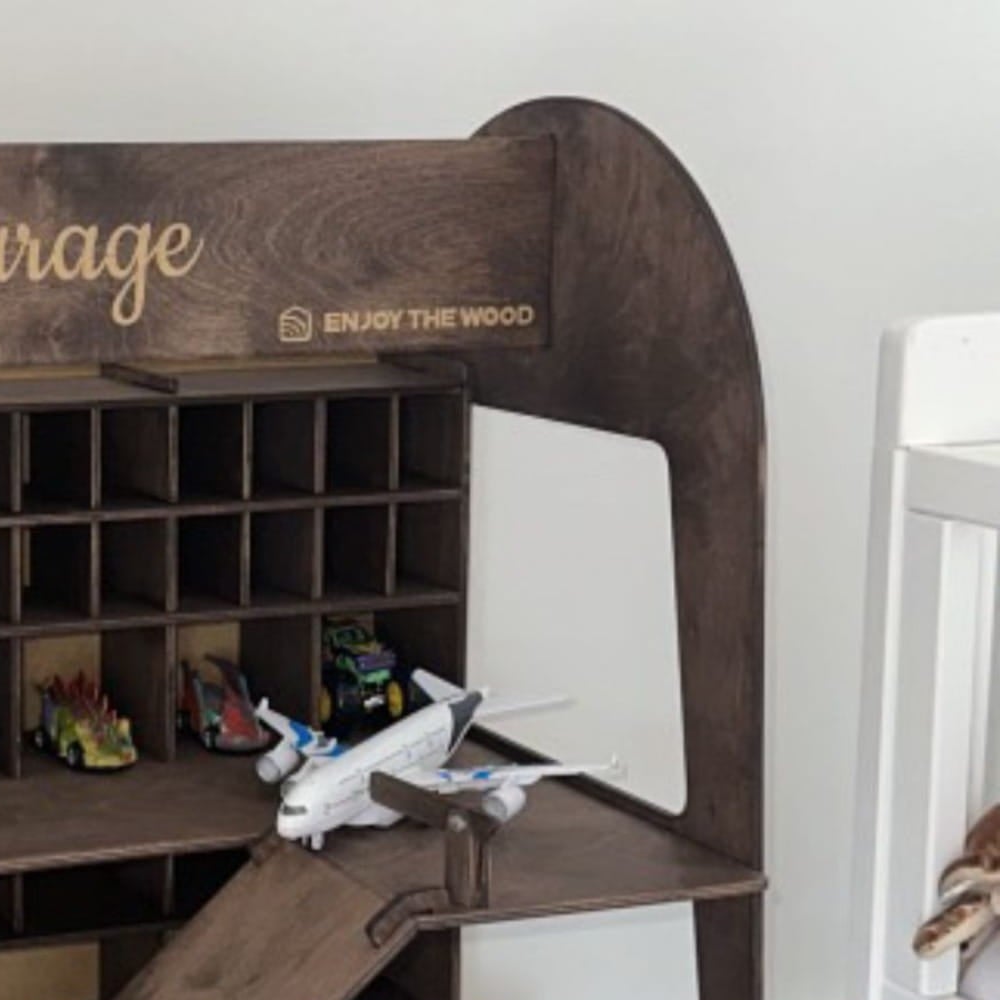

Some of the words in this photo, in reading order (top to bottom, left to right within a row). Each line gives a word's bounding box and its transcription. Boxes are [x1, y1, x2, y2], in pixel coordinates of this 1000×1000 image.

[323, 312, 402, 333] ENJOY
[408, 307, 456, 329] THE
[459, 305, 534, 328] WOOD
